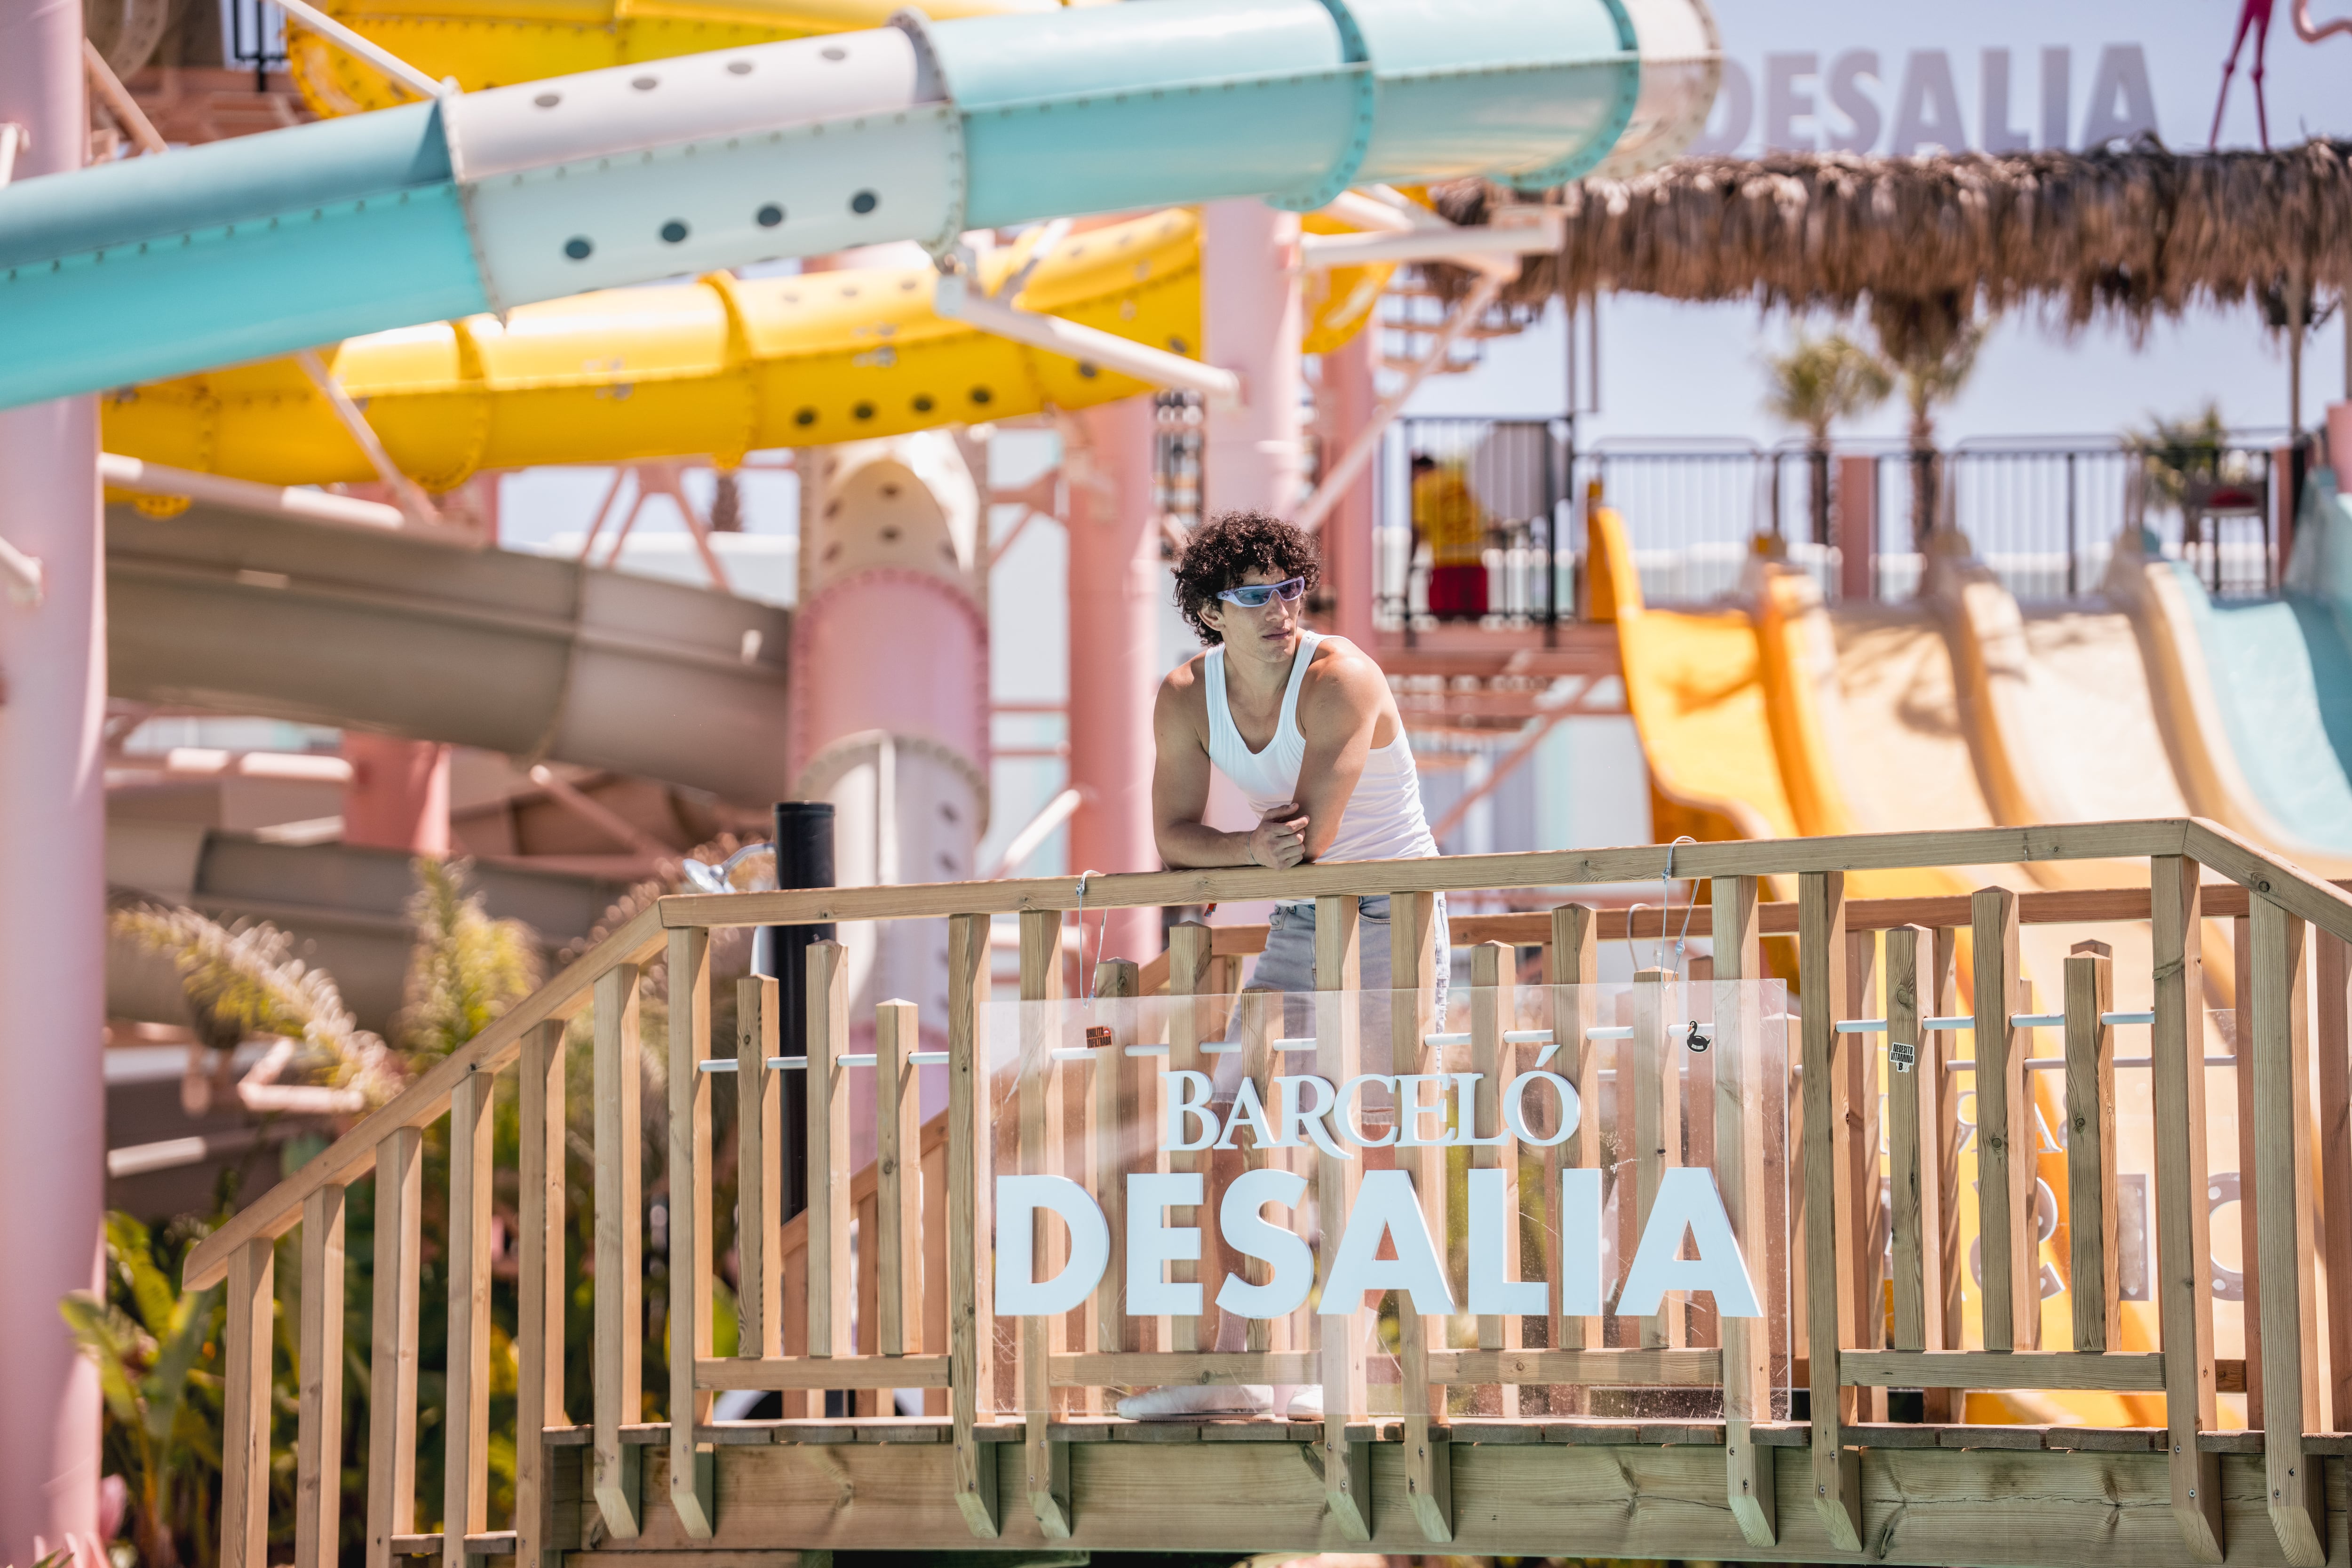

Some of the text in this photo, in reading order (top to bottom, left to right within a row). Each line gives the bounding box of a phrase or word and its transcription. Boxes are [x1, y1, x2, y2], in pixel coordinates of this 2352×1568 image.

[1891, 1052, 1913, 1064] VITAMINA
[1893, 1043, 1913, 1055] NECESITO
[1160, 1045, 1581, 1160] BARCELÓ
[995, 1167, 1764, 1318] DESALIA
